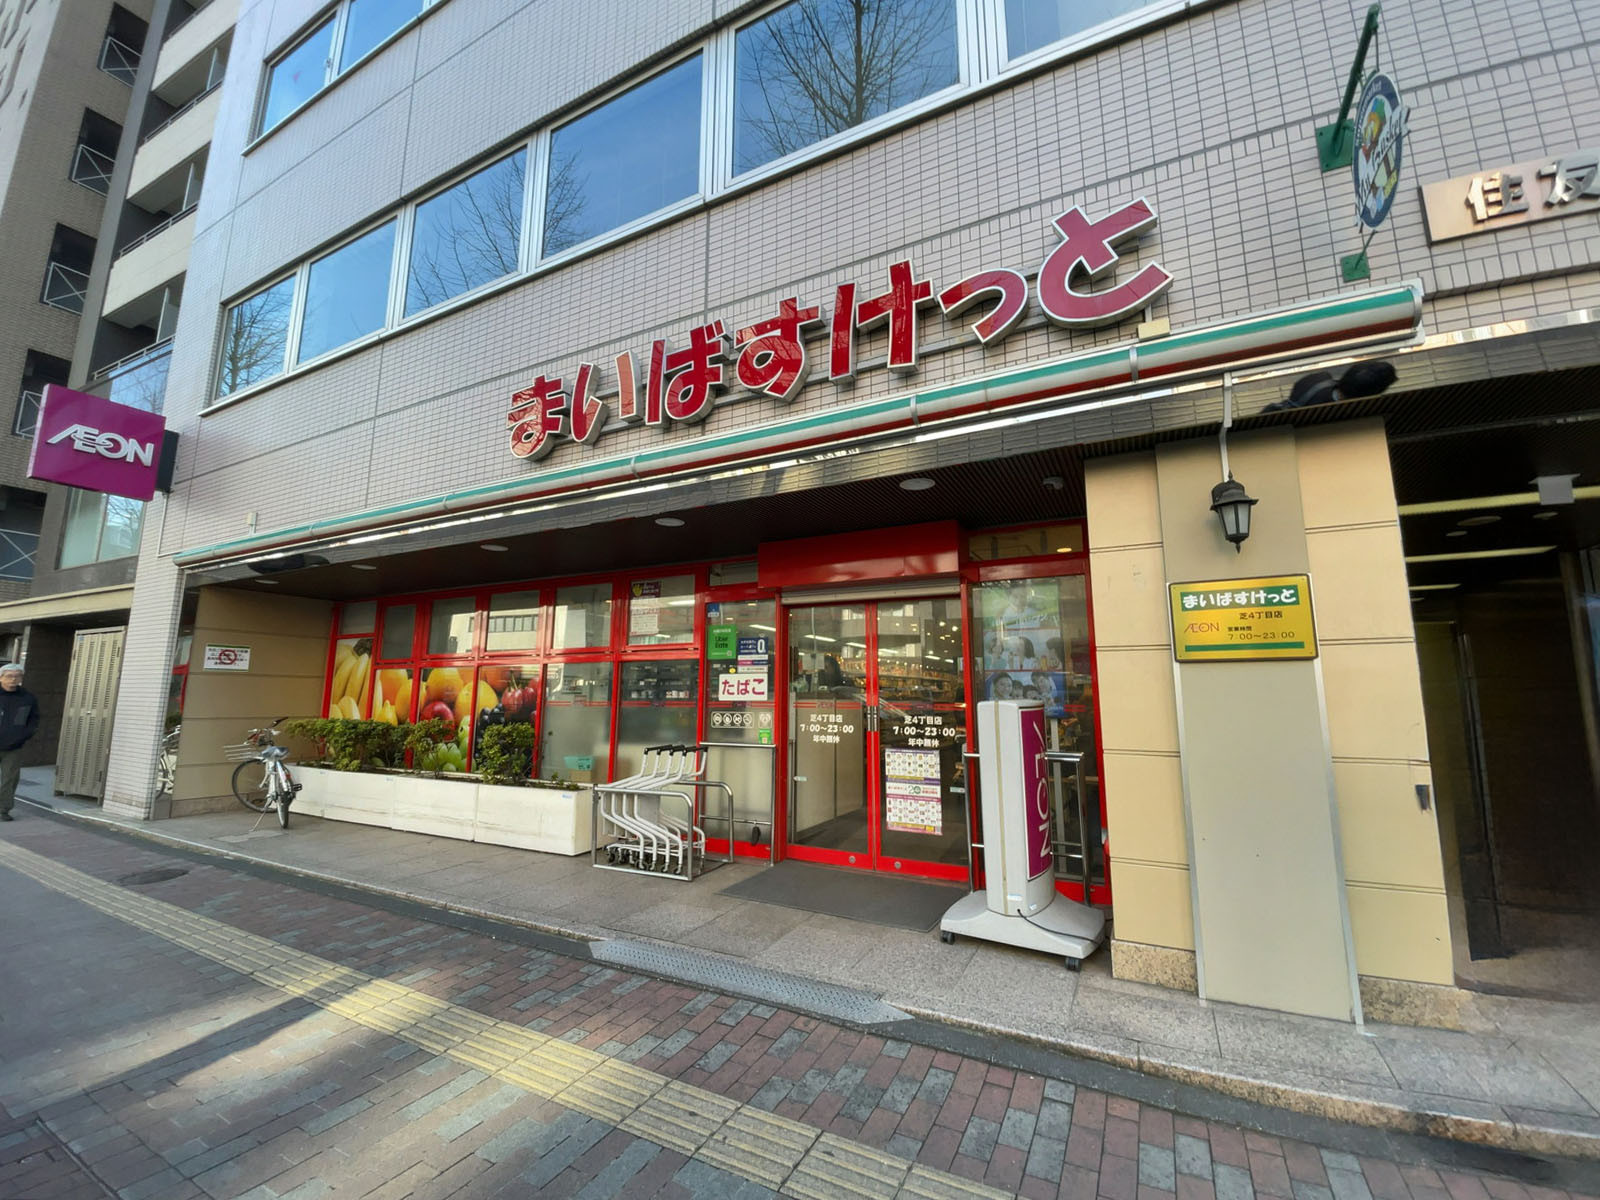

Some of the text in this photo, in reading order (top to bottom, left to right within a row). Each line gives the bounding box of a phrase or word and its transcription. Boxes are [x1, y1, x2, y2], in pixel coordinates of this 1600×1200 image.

[1466, 157, 1600, 221] 住友
[506, 196, 1174, 461] まいばすけっと
[1182, 588, 1298, 609] まいばすけっと
[1239, 610, 1283, 620] 芝4丁目店
[721, 678, 765, 696] たばこ
[810, 714, 843, 723] 芝4丁目店
[903, 715, 943, 725] 芝4丁目店
